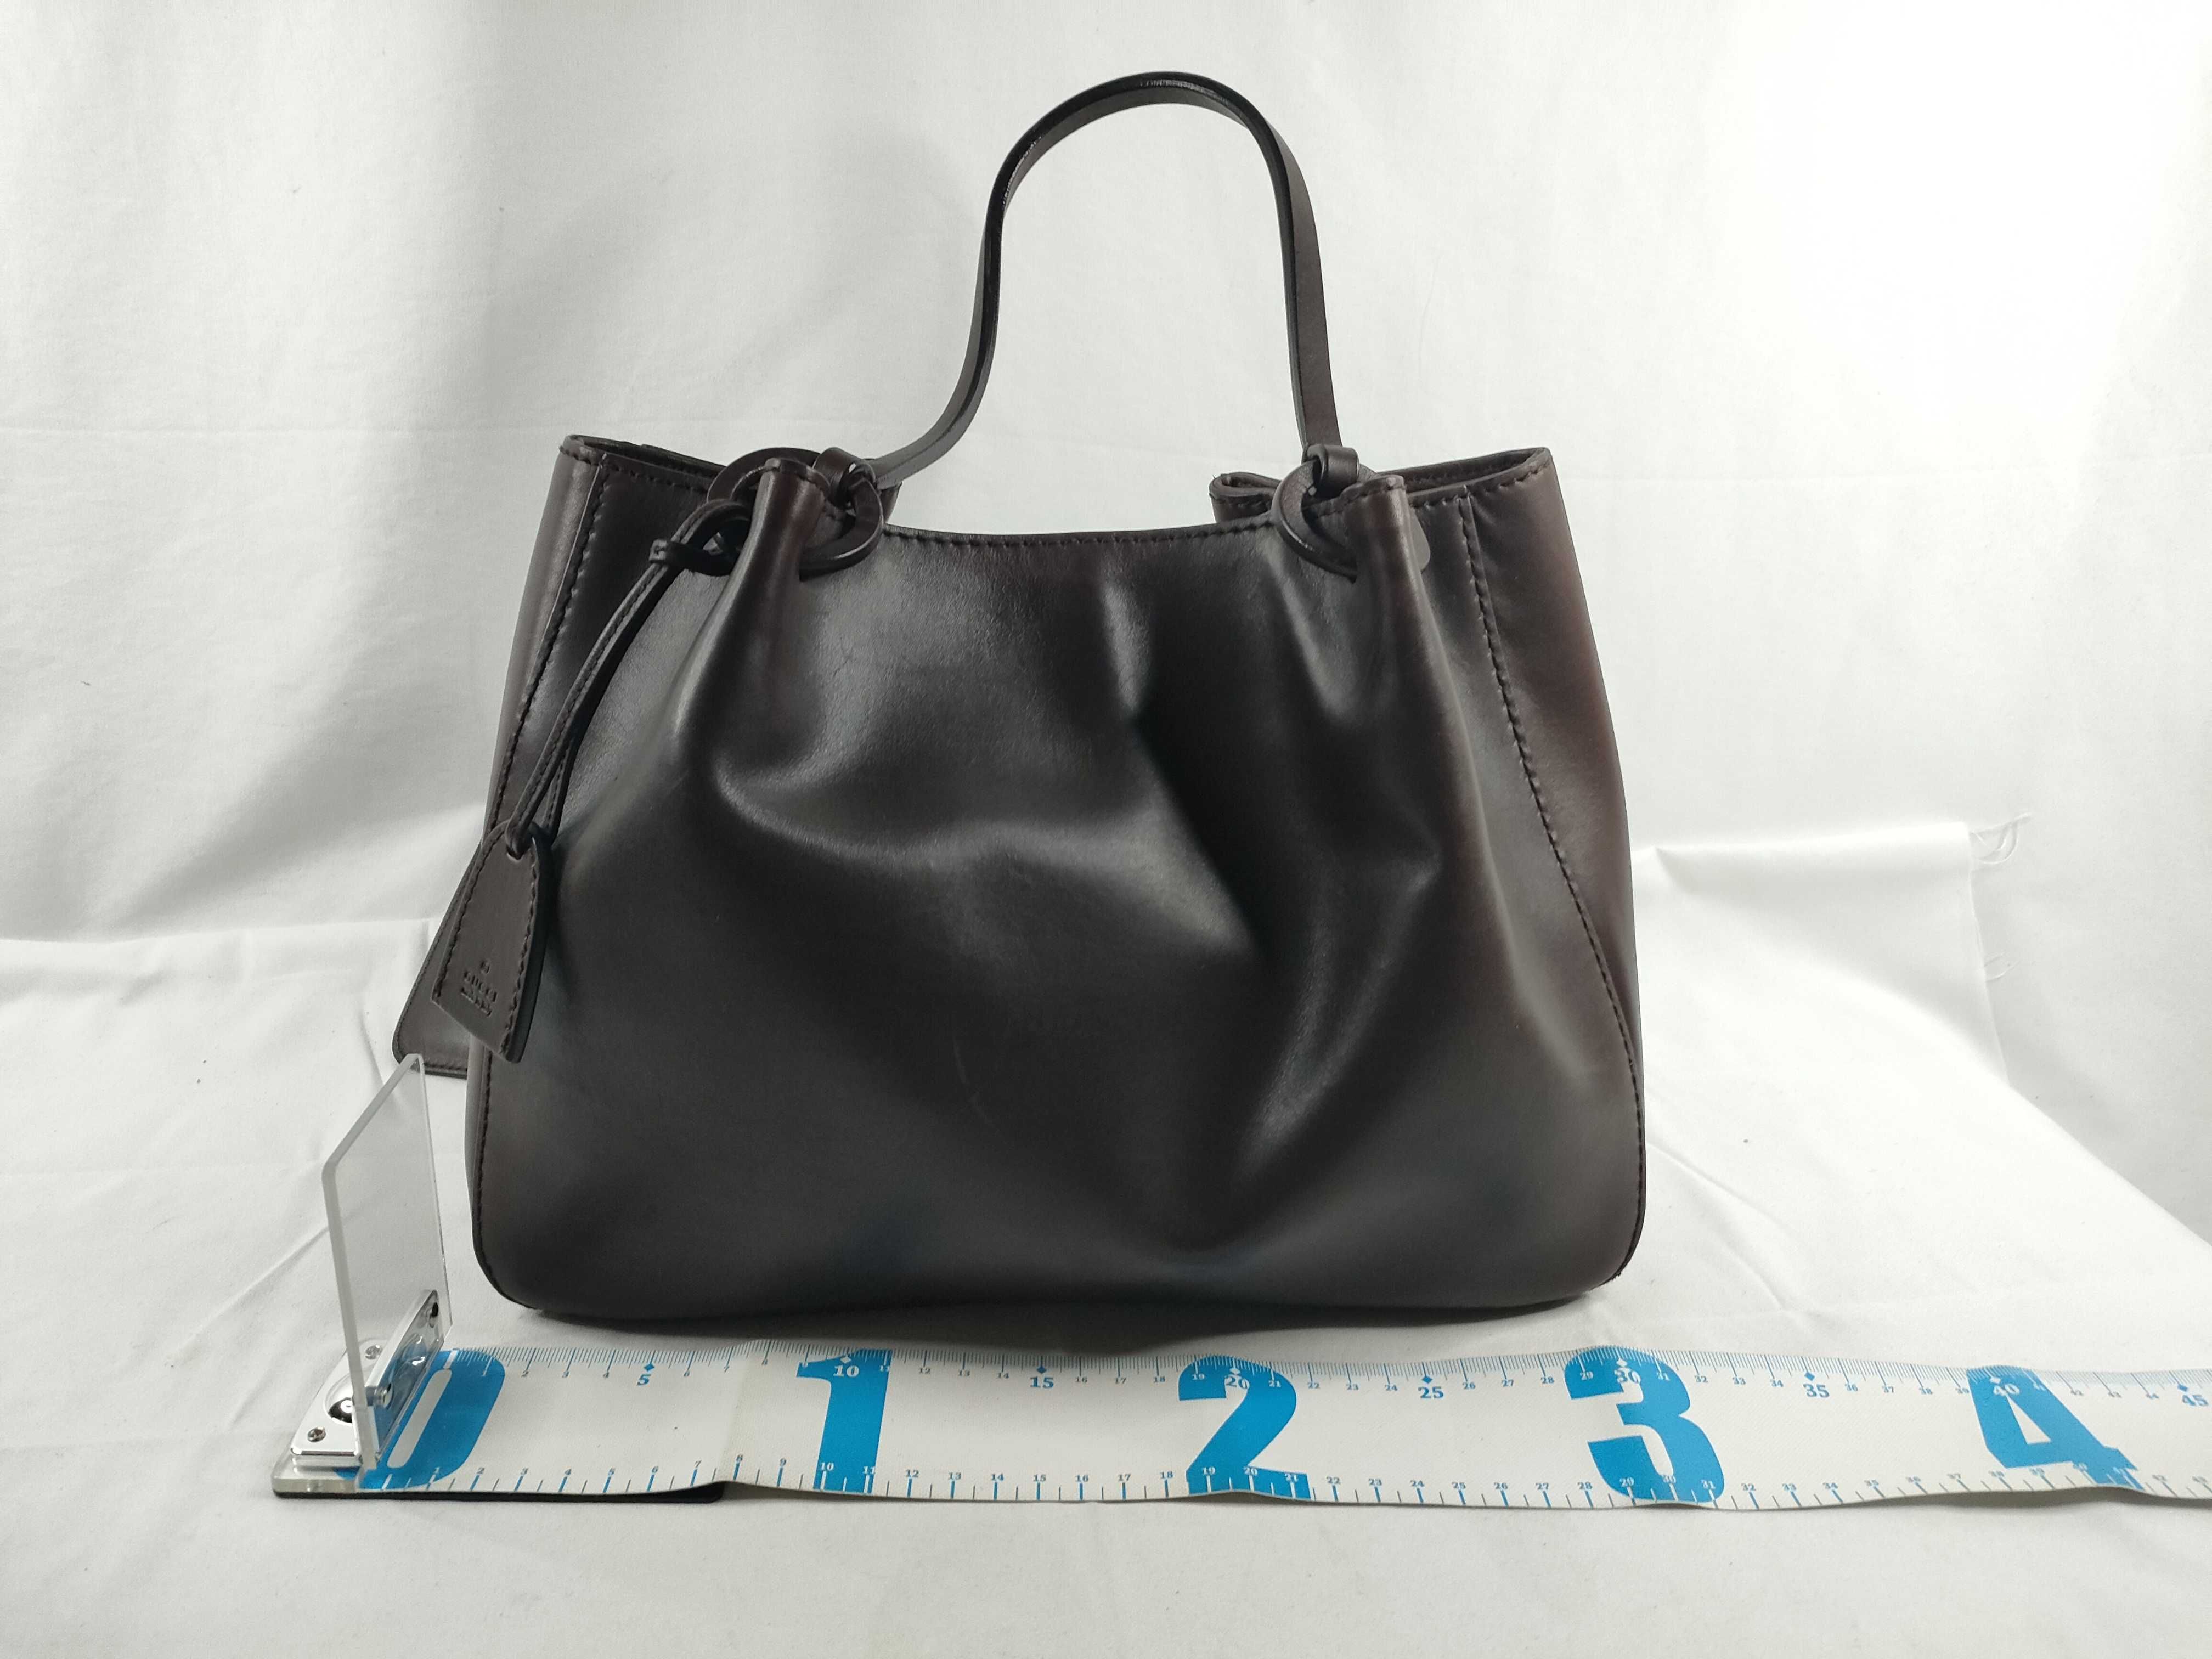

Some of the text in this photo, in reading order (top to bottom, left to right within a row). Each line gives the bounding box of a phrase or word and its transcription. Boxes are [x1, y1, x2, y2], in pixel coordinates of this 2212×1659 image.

[637, 1374, 651, 1386] 5
[833, 1365, 859, 1377] 10
[1030, 1376, 1054, 1389] 15
[1225, 1374, 1250, 1390] 20
[1418, 1386, 1444, 1399] 25
[1579, 1372, 1594, 1380] 29
[1614, 1368, 1641, 1384] 30
[1657, 1373, 1671, 1381] 31
[1694, 1375, 1708, 1383] 32
[1803, 1384, 1830, 1398] 35
[1845, 1384, 1858, 1392] 36
[1993, 1383, 2020, 1396] 40
[2182, 1395, 2208, 1406] 45
[335, 1345, 2145, 1503] 0 1 2 3 4
[820, 1463, 834, 1471] 10
[862, 1466, 876, 1475] 11
[948, 1472, 962, 1480] 13
[1160, 1471, 1173, 1479] 18
[1202, 1467, 1215, 1475] 19
[1243, 1466, 1257, 1476] 20
[1285, 1474, 1298, 1482] 21
[1368, 1478, 1383, 1486] 23
[1620, 1477, 1634, 1487] 29
[1701, 1479, 1716, 1490] 31
[1741, 1483, 1756, 1491] 32
[1782, 1483, 1797, 1491] 33
